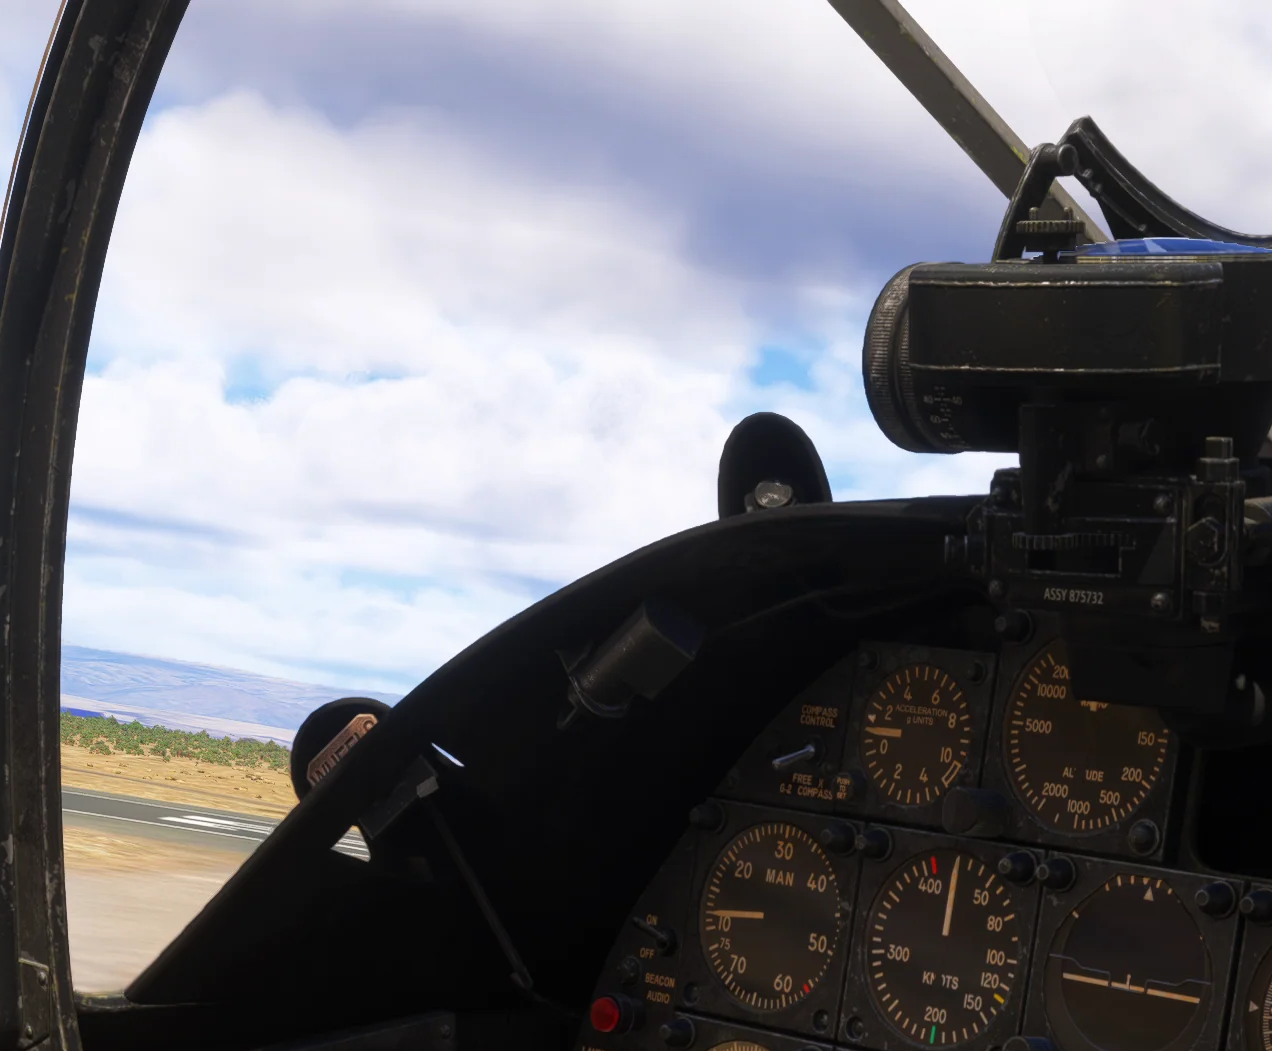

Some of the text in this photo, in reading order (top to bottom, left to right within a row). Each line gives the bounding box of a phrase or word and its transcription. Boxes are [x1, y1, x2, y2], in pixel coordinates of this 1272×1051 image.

[1044, 587, 1104, 605] ASSY 875732
[1037, 683, 1066, 700] 10000
[801, 704, 838, 718] COMPASS
[895, 704, 948, 718] ACCELERATION
[800, 715, 836, 728] CONTROL
[912, 715, 933, 726] UNITS
[1025, 719, 1052, 734] 5000
[1138, 731, 1155, 746] 150
[792, 773, 812, 786] FREE
[1121, 767, 1142, 783] 200
[1042, 782, 1068, 798] 2000
[1099, 790, 1120, 806] 500
[1067, 799, 1090, 815] 1000
[774, 841, 793, 863] 30
[734, 860, 753, 879] 20
[765, 869, 794, 889] MAN
[806, 873, 827, 894] 40
[917, 878, 942, 895] 400
[973, 889, 989, 907] 50
[986, 915, 1003, 933] 80
[808, 934, 828, 954] 50
[639, 948, 655, 959] OFF
[887, 945, 910, 964] 300
[985, 949, 1005, 968] 100
[730, 955, 747, 975] 70
[645, 973, 675, 989] BEACON
[773, 974, 793, 993] 60
[980, 971, 1000, 989] 120
[646, 990, 670, 1004] AUDIO
[963, 993, 982, 1012] 150
[924, 1006, 947, 1025] 200
